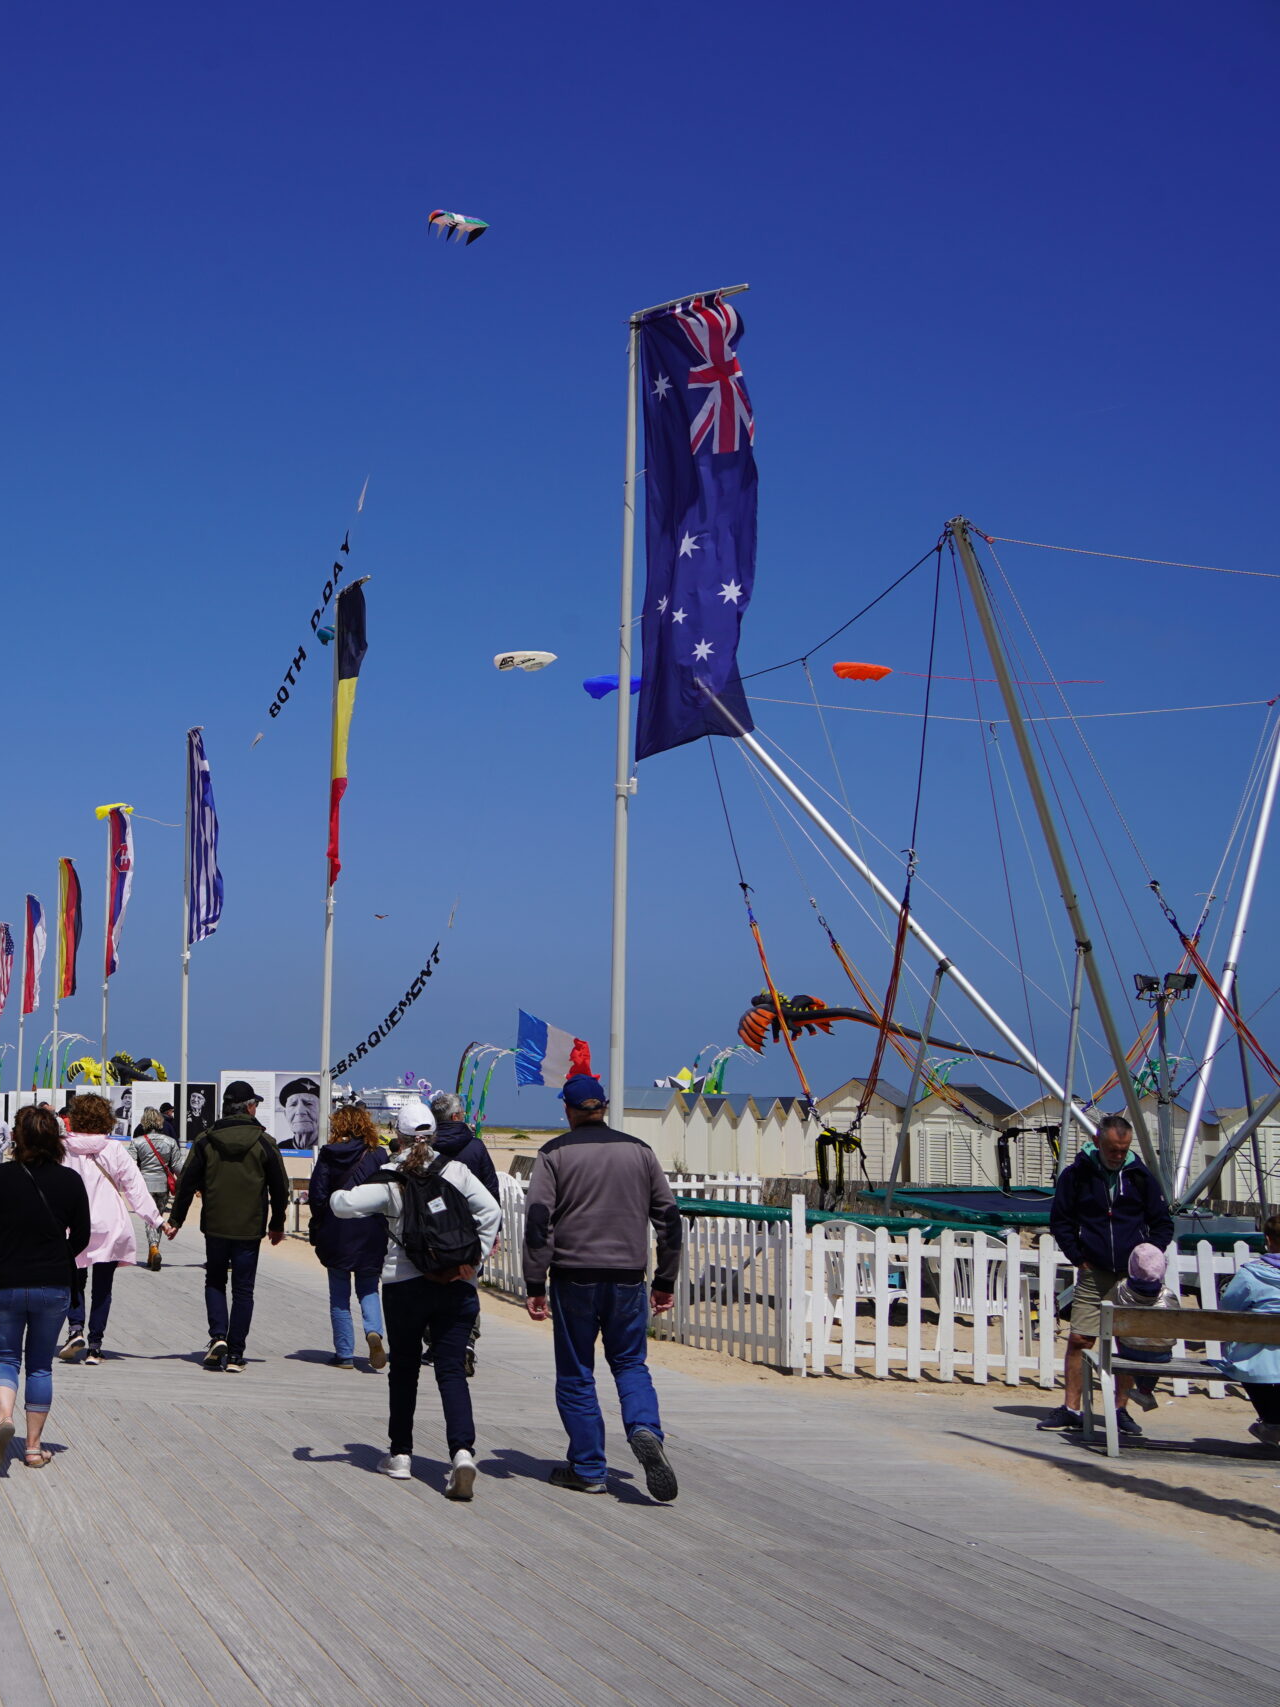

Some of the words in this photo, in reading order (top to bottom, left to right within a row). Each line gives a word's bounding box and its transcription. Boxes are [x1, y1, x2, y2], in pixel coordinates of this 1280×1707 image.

[269, 645, 307, 719] 80TH
[310, 530, 350, 633] D-DAY
[329, 941, 440, 1081] EBARQUEMENT
